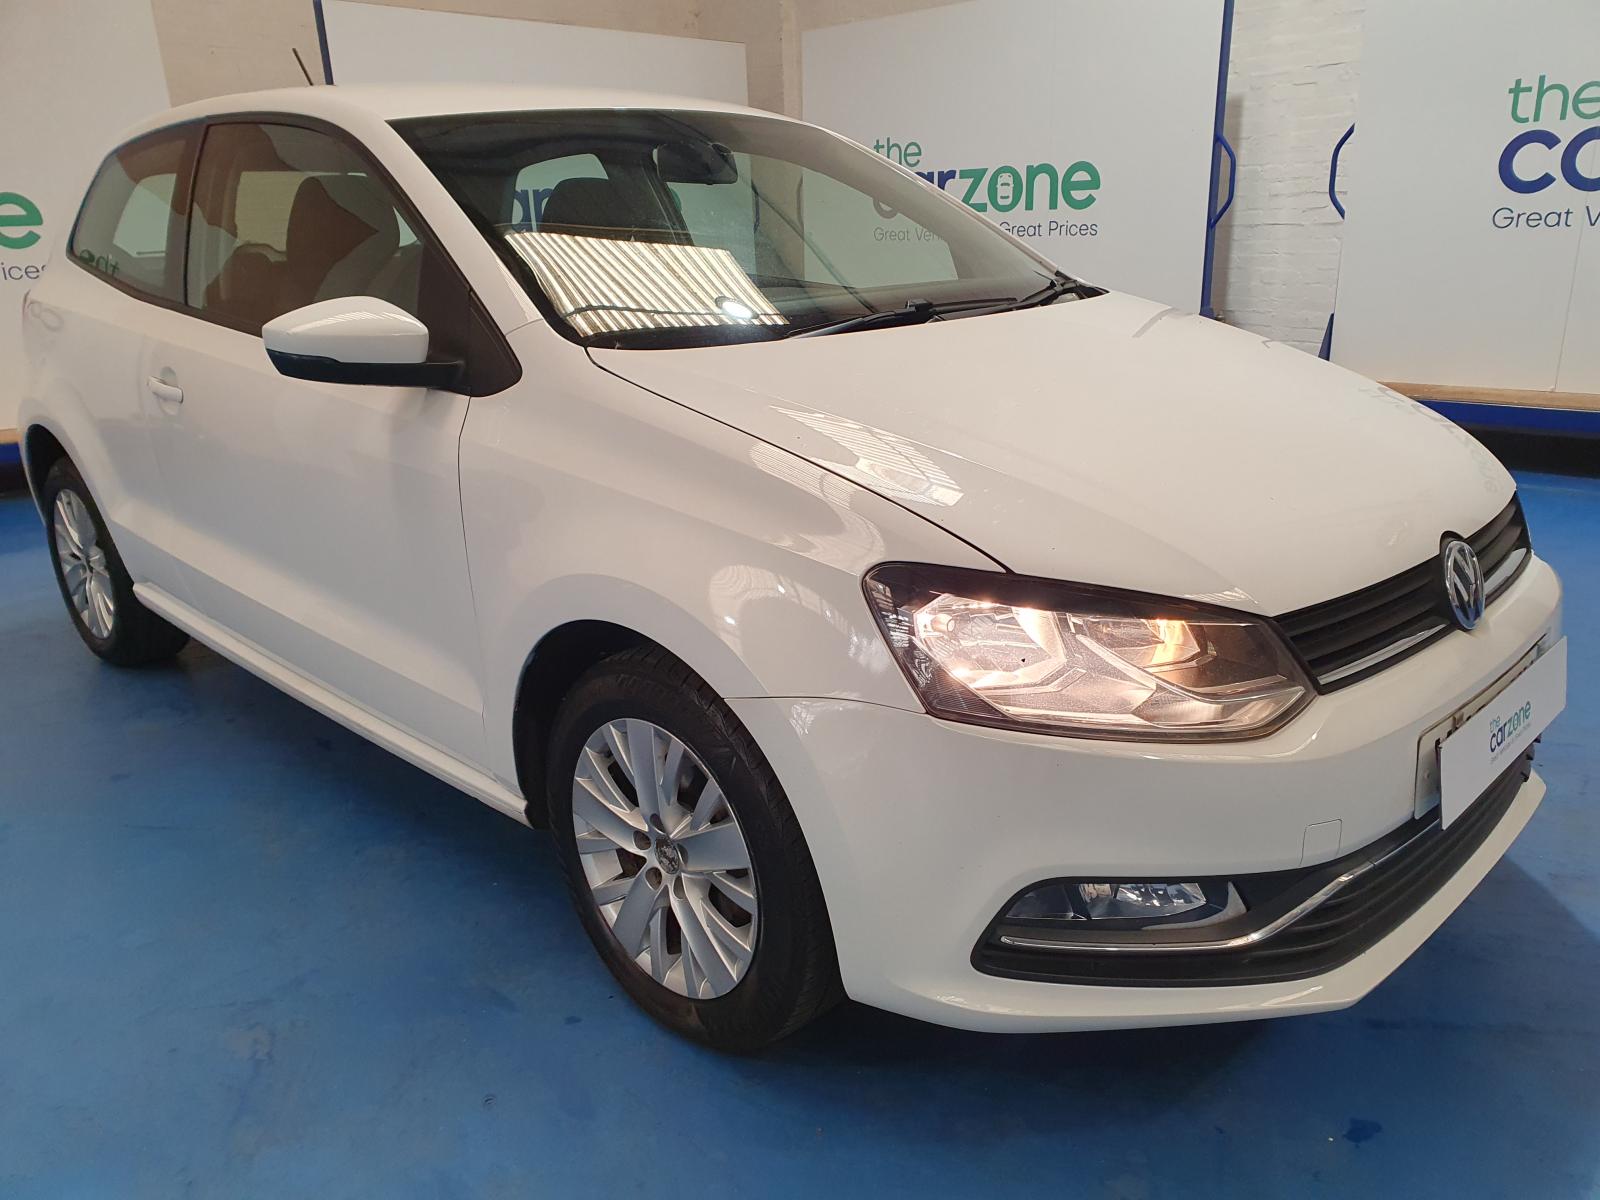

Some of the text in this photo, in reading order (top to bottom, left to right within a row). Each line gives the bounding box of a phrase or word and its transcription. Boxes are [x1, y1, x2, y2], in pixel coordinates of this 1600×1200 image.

[1508, 75, 1600, 124] the
[873, 137, 922, 168] the
[873, 161, 1101, 218] rzone
[1000, 219, 1098, 237] Great Prices
[1492, 207, 1573, 228] Great
[873, 227, 911, 242] Great
[0, 262, 46, 281] ice
[1489, 701, 1531, 753] carzone
